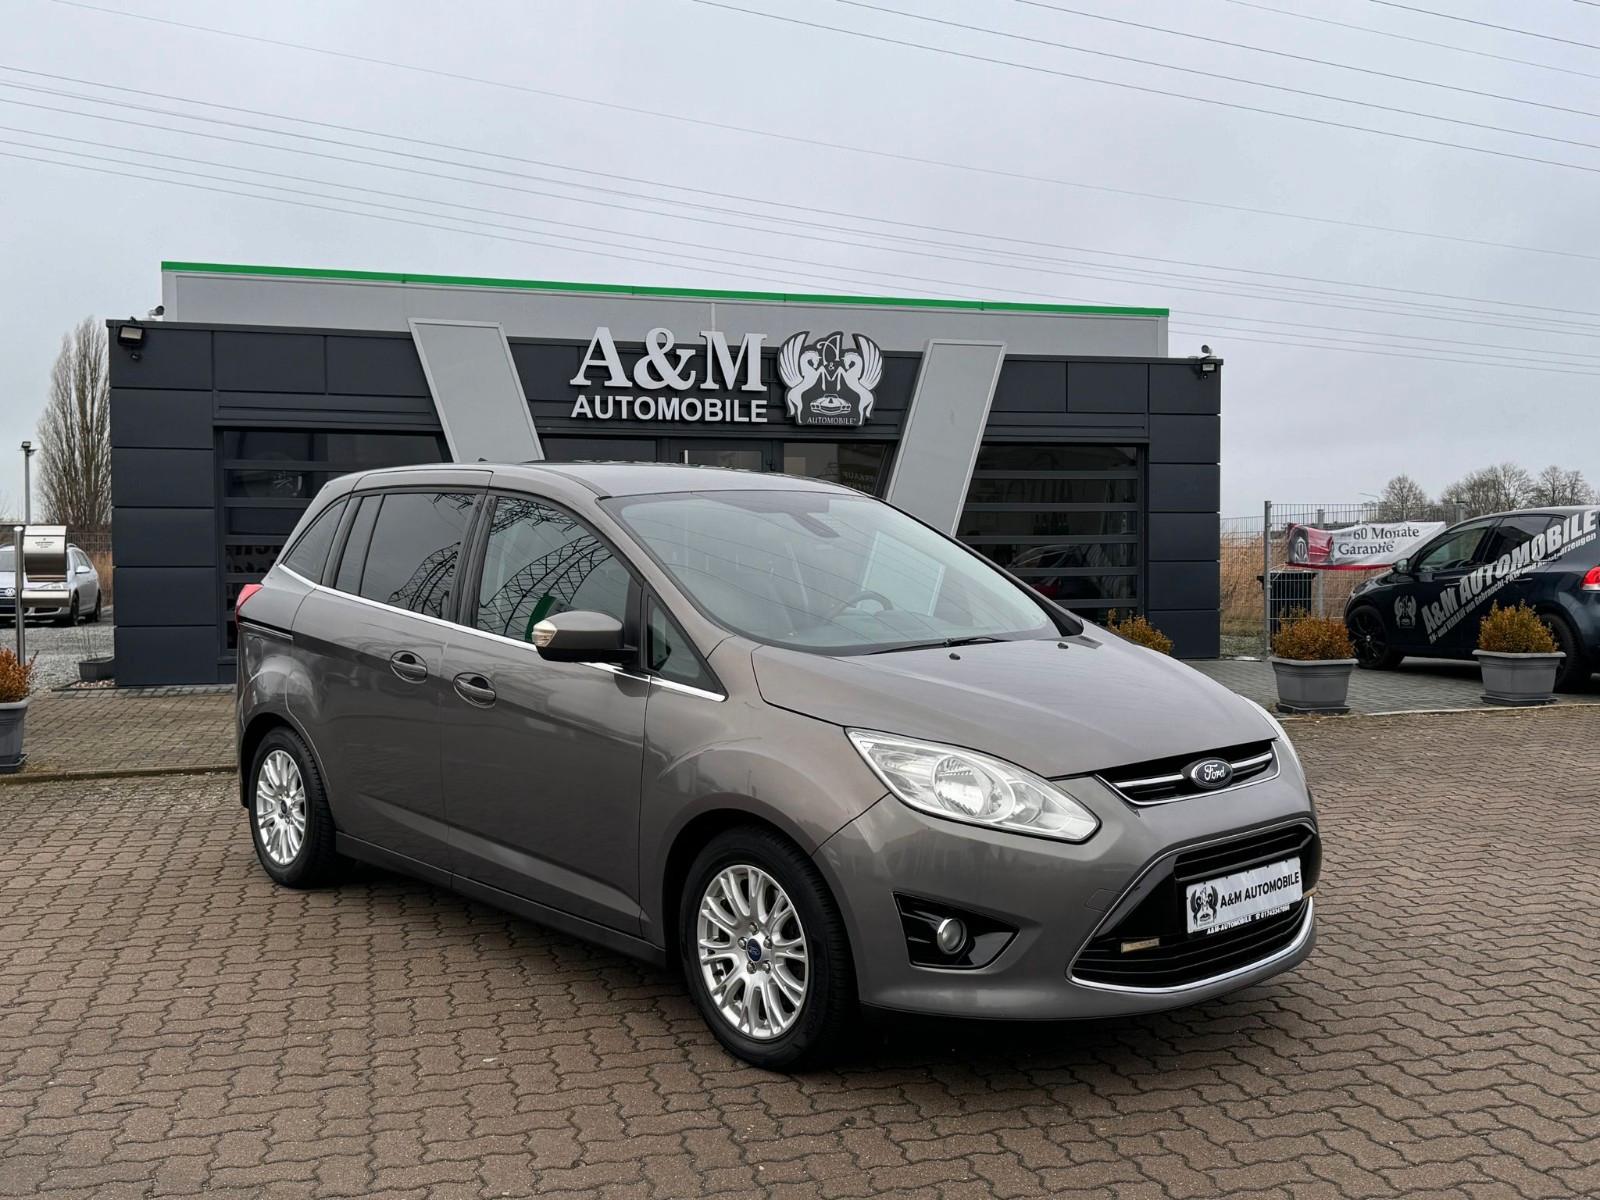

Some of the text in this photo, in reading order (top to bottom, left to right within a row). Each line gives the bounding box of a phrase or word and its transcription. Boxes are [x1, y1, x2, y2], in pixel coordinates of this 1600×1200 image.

[569, 326, 768, 393] A&M
[569, 394, 768, 423] AUTOMOBILE
[1353, 526, 1419, 540] 60 Monate
[1421, 587, 1459, 635] A&M
[1459, 510, 1597, 605] AUTOMOBILE
[1204, 763, 1226, 781] Ford
[1220, 871, 1300, 909] A&M AUTOMOBILE
